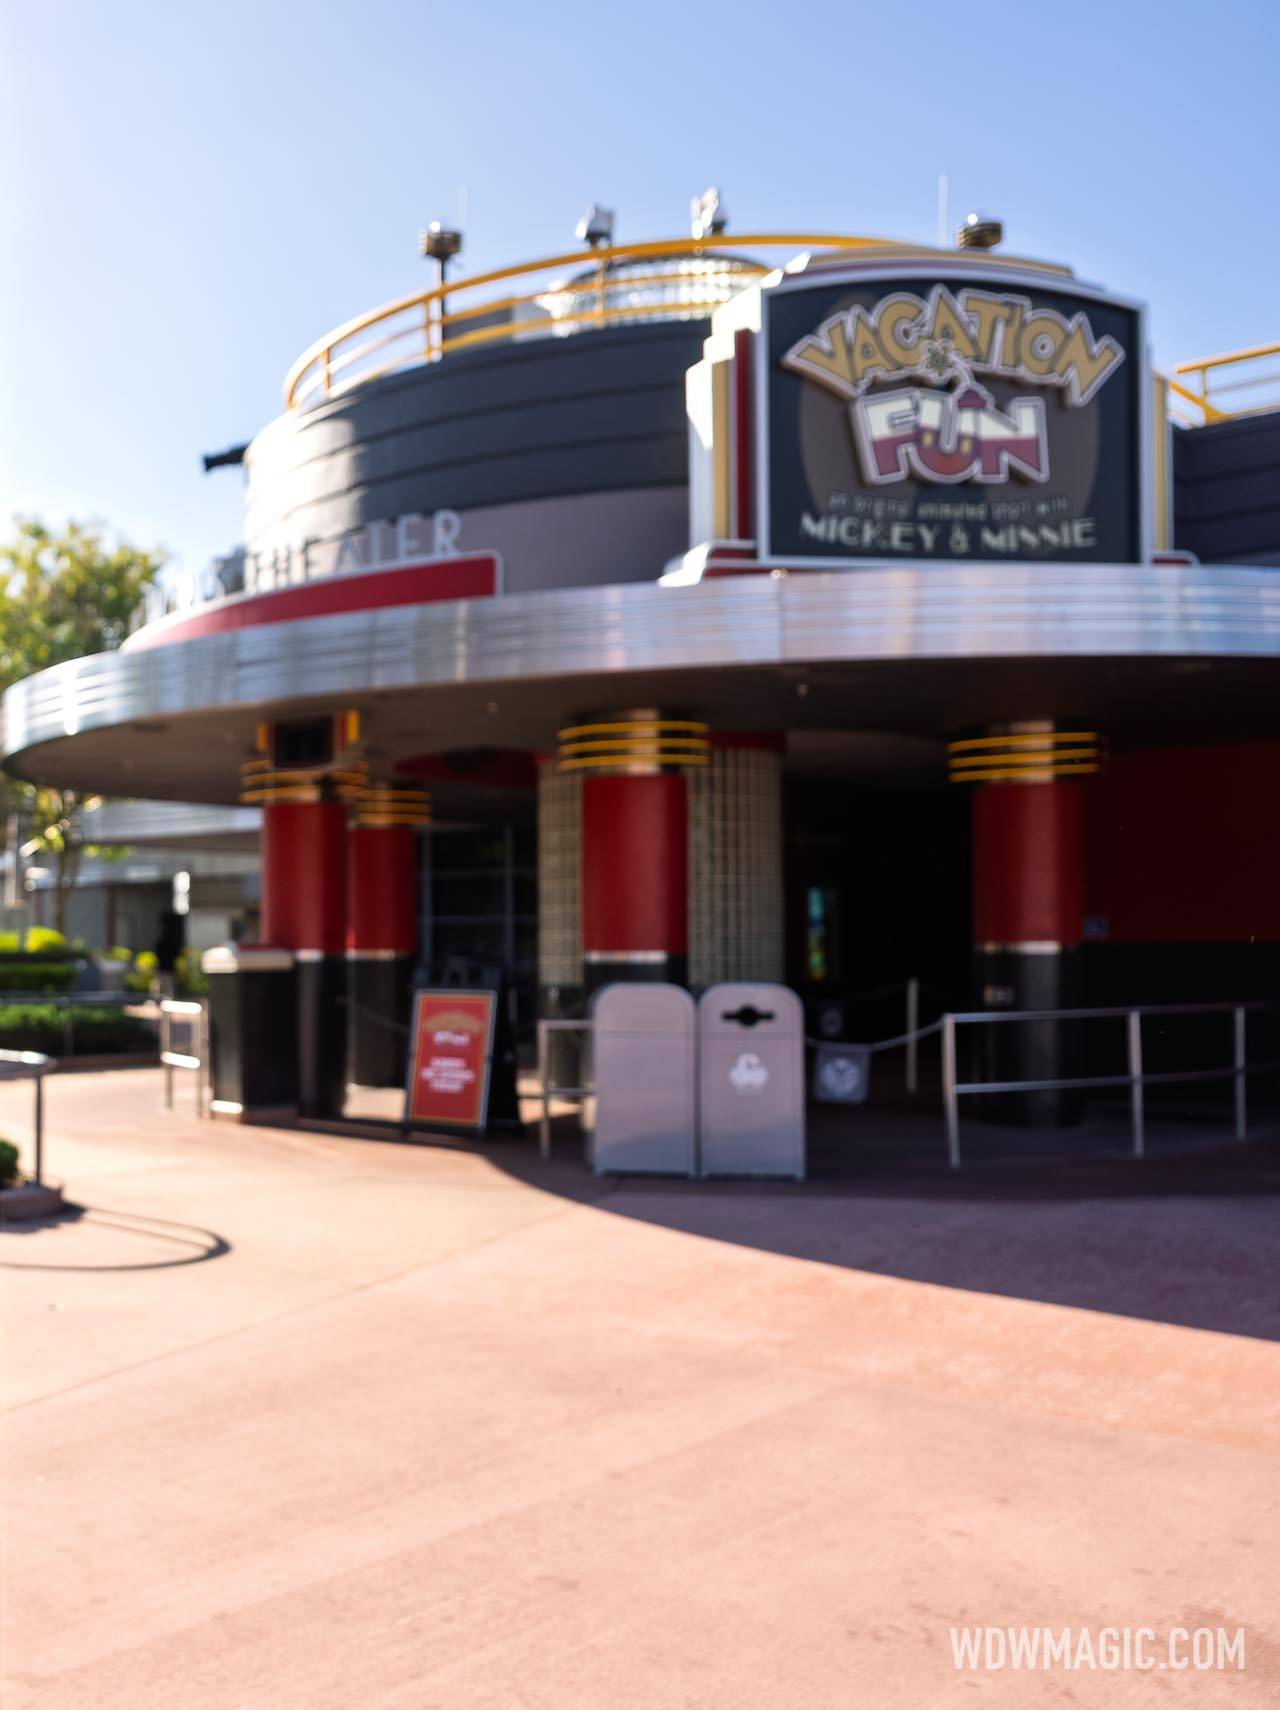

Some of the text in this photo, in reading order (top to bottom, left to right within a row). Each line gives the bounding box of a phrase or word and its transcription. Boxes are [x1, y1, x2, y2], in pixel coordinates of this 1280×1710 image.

[781, 283, 1125, 407] VACATION
[854, 384, 1050, 486] FUN
[801, 511, 939, 551] MICKEY
[981, 517, 1097, 553] MINNIE
